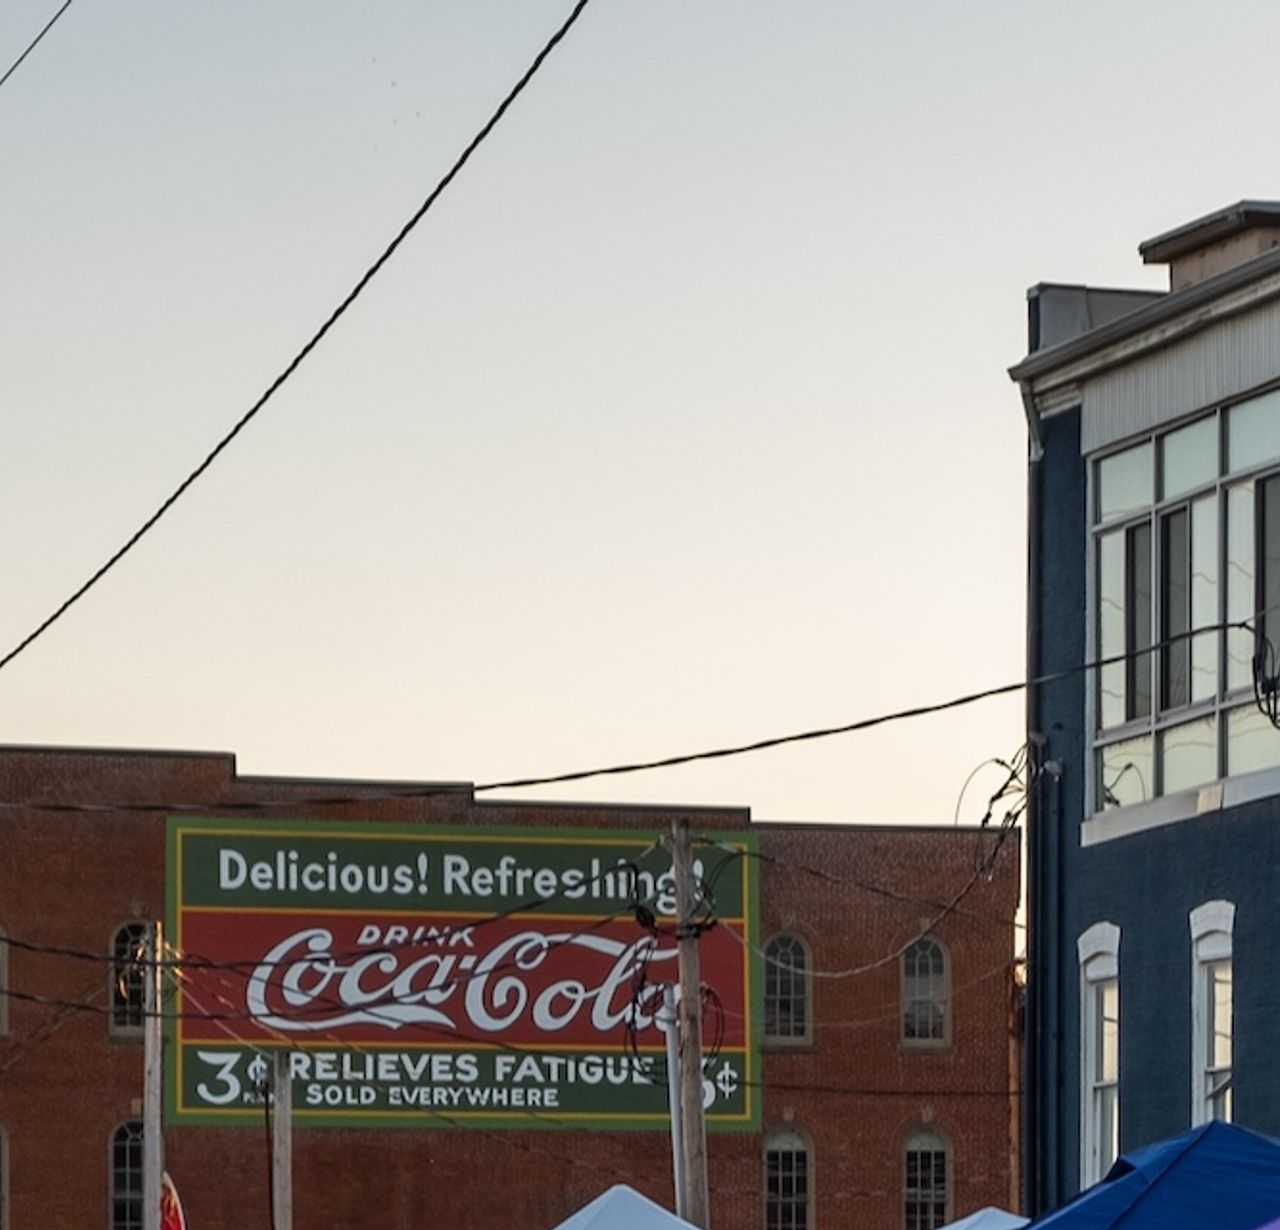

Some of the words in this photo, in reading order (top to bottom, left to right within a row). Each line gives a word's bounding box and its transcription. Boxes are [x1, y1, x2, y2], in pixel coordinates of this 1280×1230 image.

[219, 848, 429, 894] Delicious!
[443, 857, 704, 915] Refreshing!
[356, 924, 475, 947] DRINK
[290, 1052, 479, 1083] RELIEVES
[495, 1054, 655, 1085] FATIGUE
[306, 1084, 376, 1106] SOLD
[388, 1086, 559, 1107] EVERYWHERE
